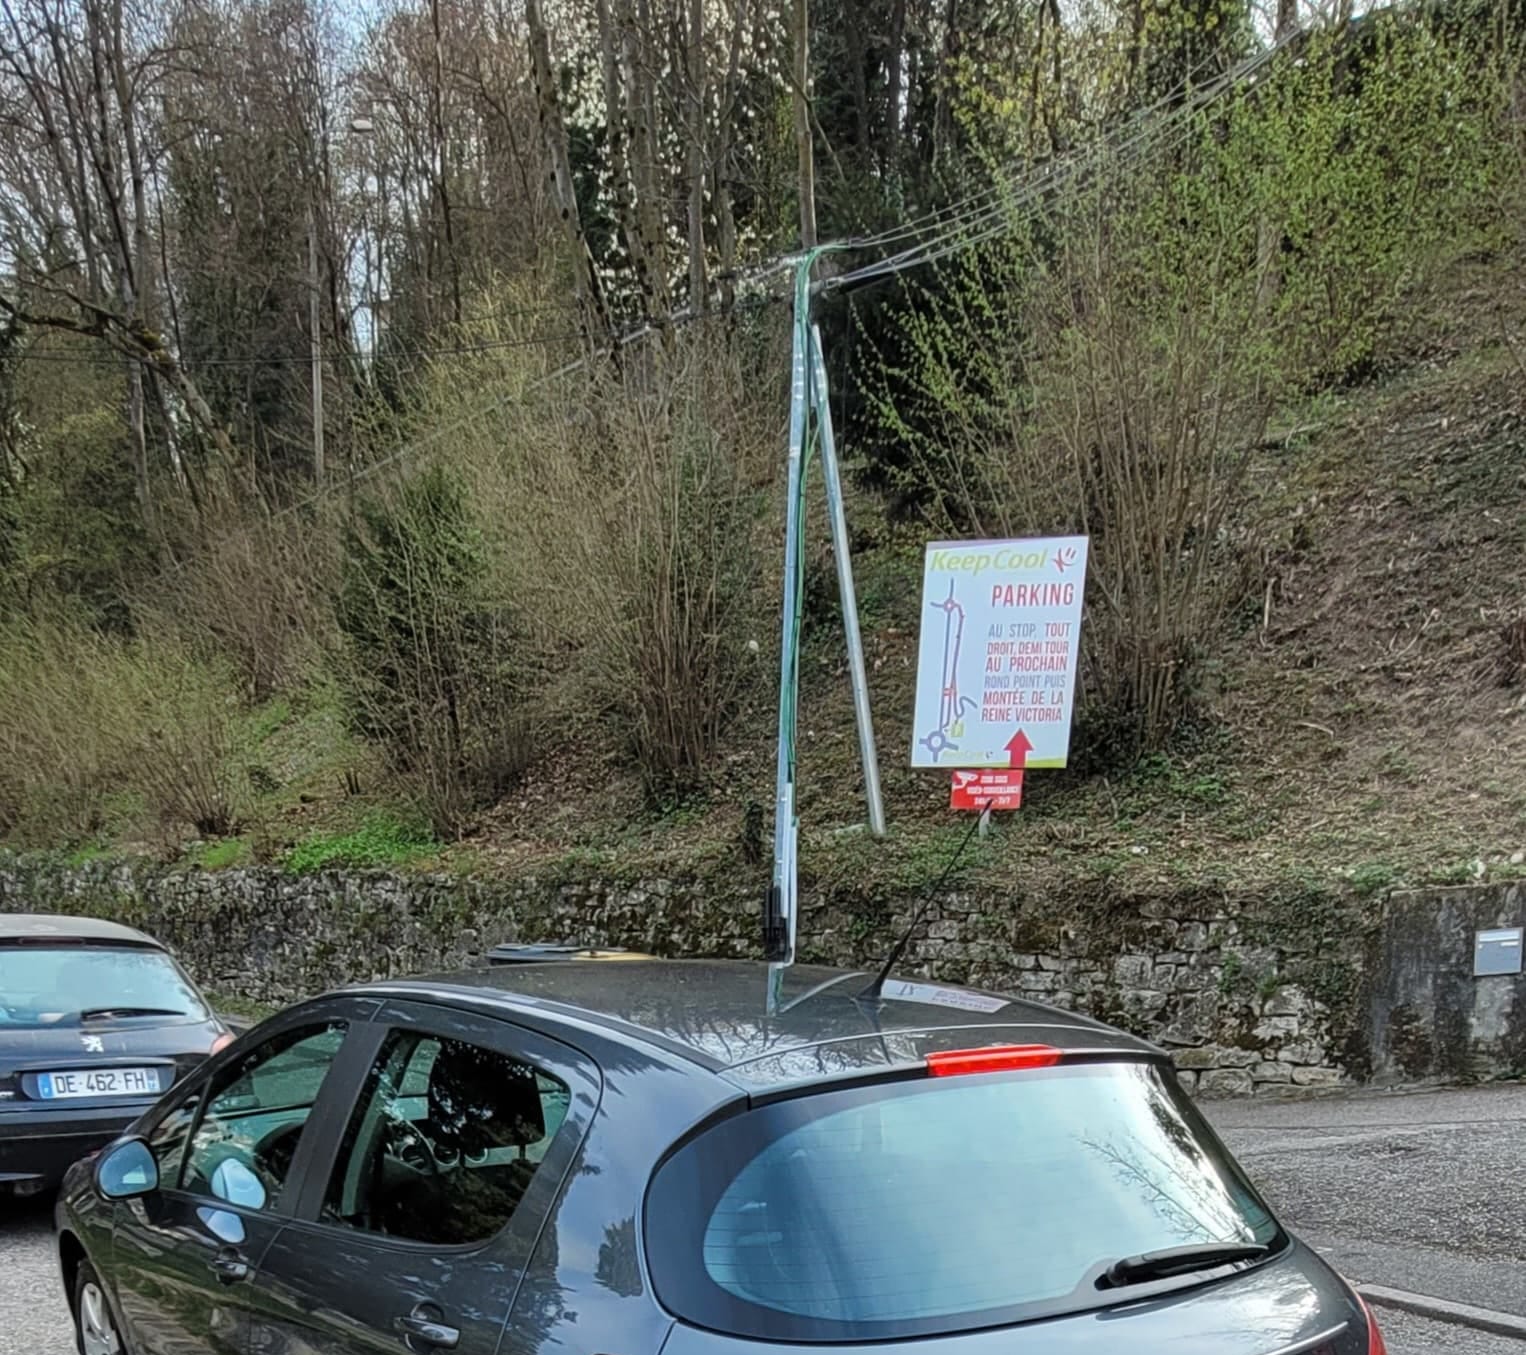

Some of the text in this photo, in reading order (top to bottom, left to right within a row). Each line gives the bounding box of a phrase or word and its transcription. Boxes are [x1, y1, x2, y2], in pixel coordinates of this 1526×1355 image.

[992, 583, 1074, 608] PARKING
[988, 623, 1003, 638] AU
[1045, 622, 1072, 638] TOUT
[1018, 641, 1042, 655] DEMI
[1045, 641, 1069, 654] TOUR
[985, 655, 1067, 672] AU PROCHAIN
[984, 674, 1066, 688] ROND POINT PUIS
[983, 689, 1064, 705] MONTÉE DE LA
[981, 707, 1062, 722] REINE VICTORIA
